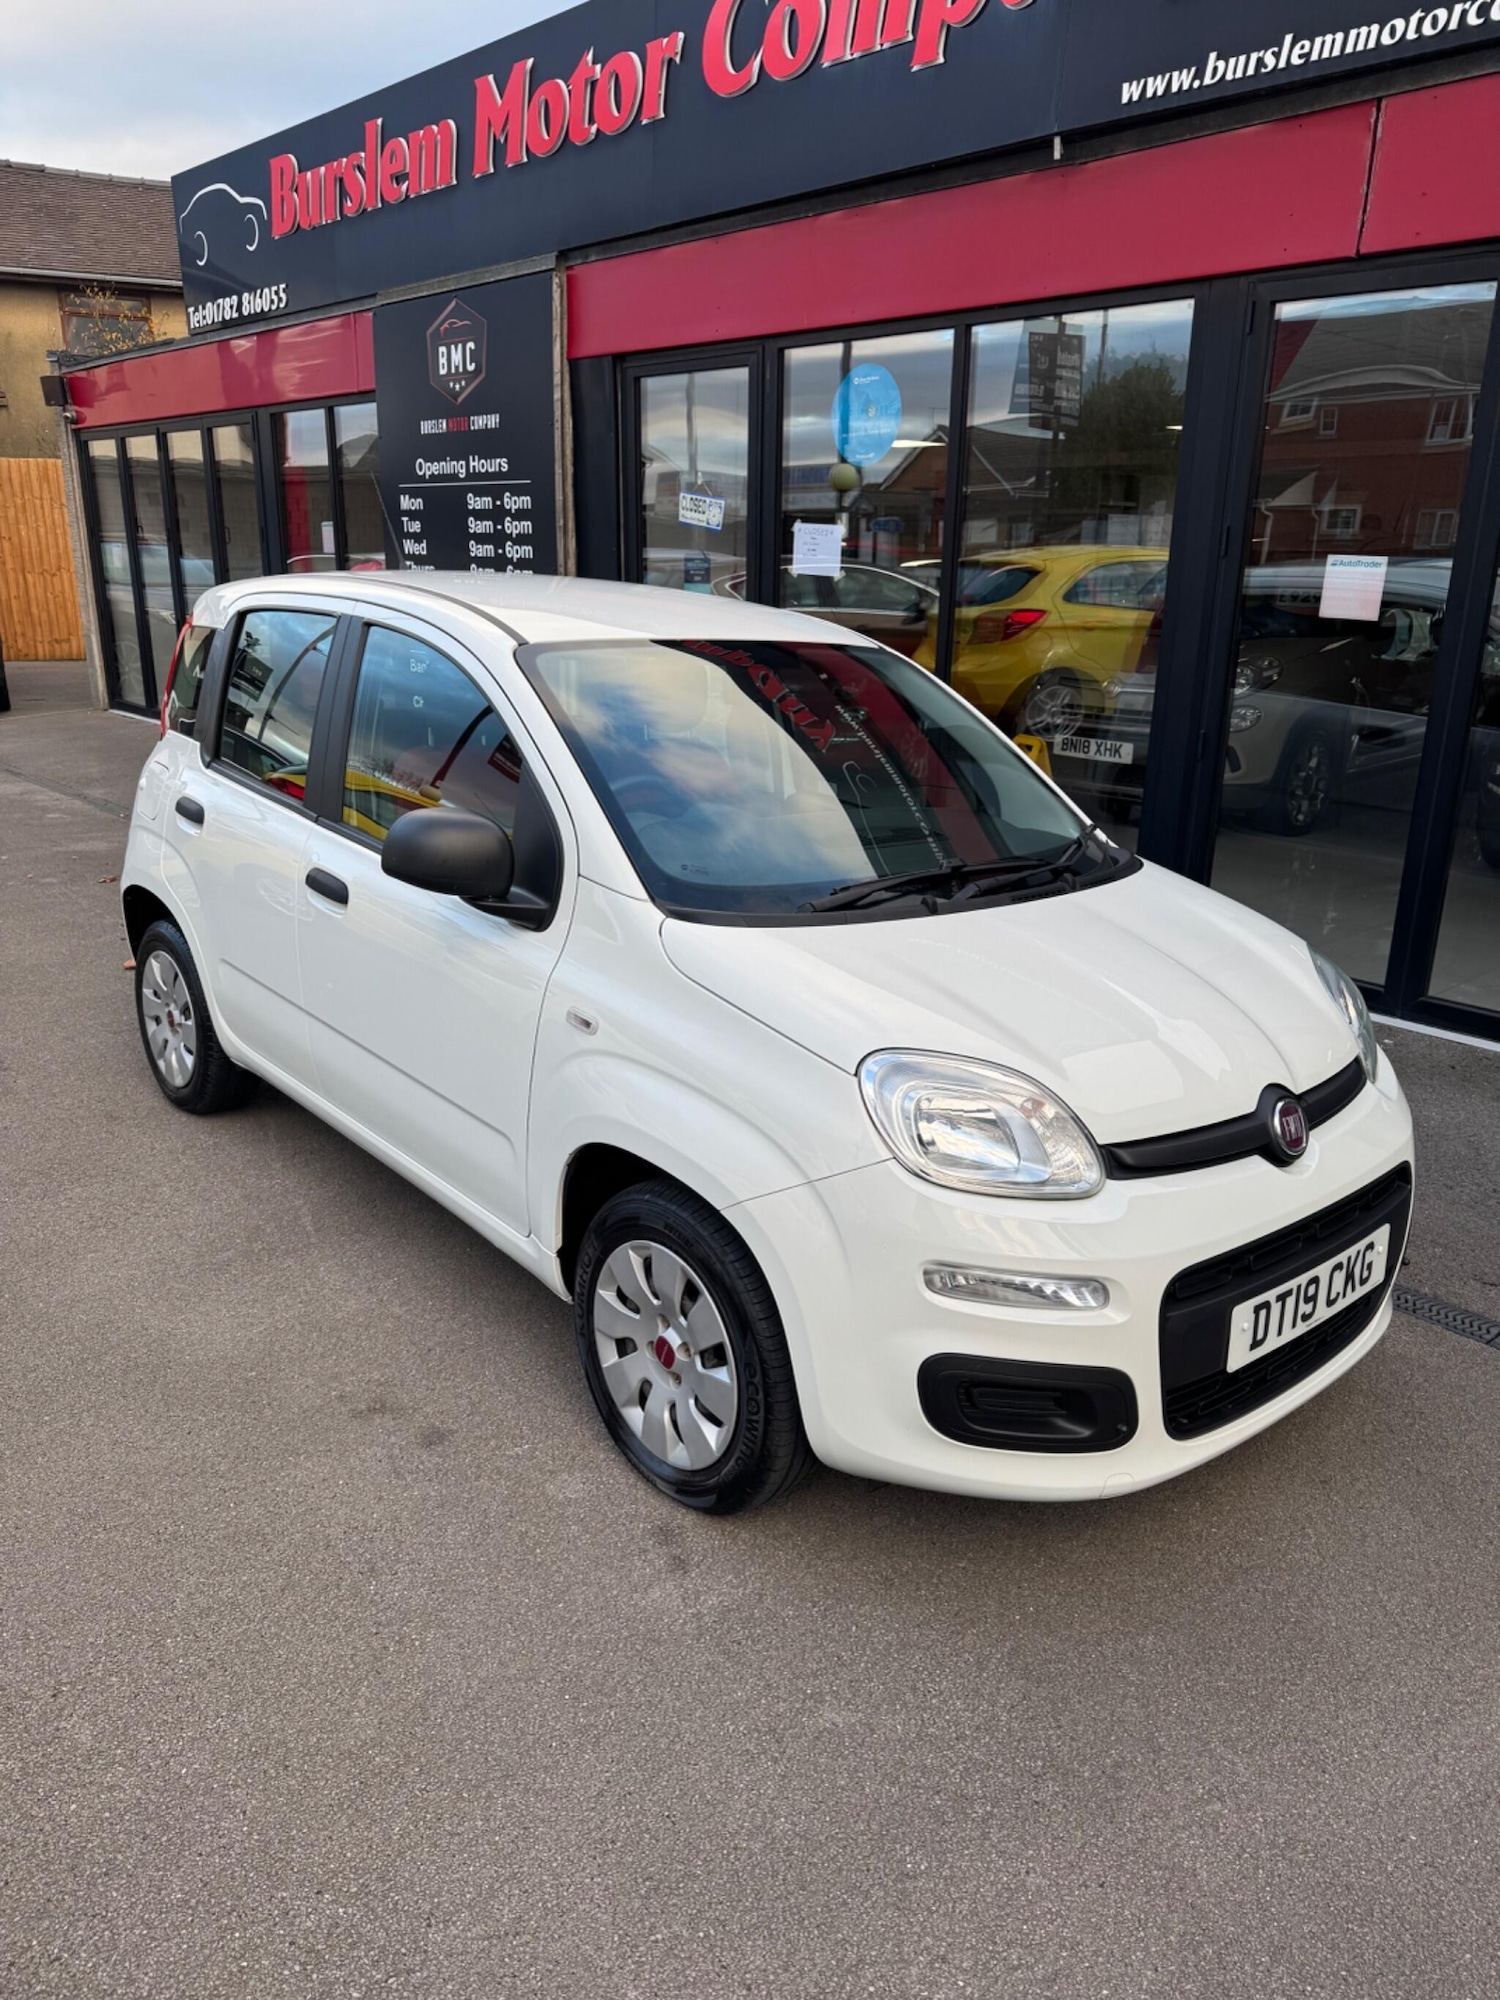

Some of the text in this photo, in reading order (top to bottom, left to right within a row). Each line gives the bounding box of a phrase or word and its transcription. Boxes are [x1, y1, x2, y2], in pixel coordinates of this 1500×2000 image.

[269, 0, 1033, 239] Burslem Motor Comp
[187, 283, 287, 329] Tel:01782 816055
[438, 341, 476, 375] BMC
[470, 413, 500, 431] COMPANY
[415, 455, 509, 480] Opening Hours
[400, 494, 424, 511] Mon
[467, 493, 493, 510] 9am
[503, 492, 532, 514] 6pm
[681, 495, 707, 515] CLOSED
[401, 517, 421, 533] Tue
[468, 517, 494, 533] 9am
[504, 517, 533, 538] 6pm
[403, 539, 427, 555] Wed
[469, 540, 495, 557] 9am
[505, 541, 533, 562] 6pm
[1338, 559, 1384, 569] AutoTrader
[1061, 737, 1123, 760] BN18 XHK
[1249, 1240, 1376, 1352] DT19 CKG
